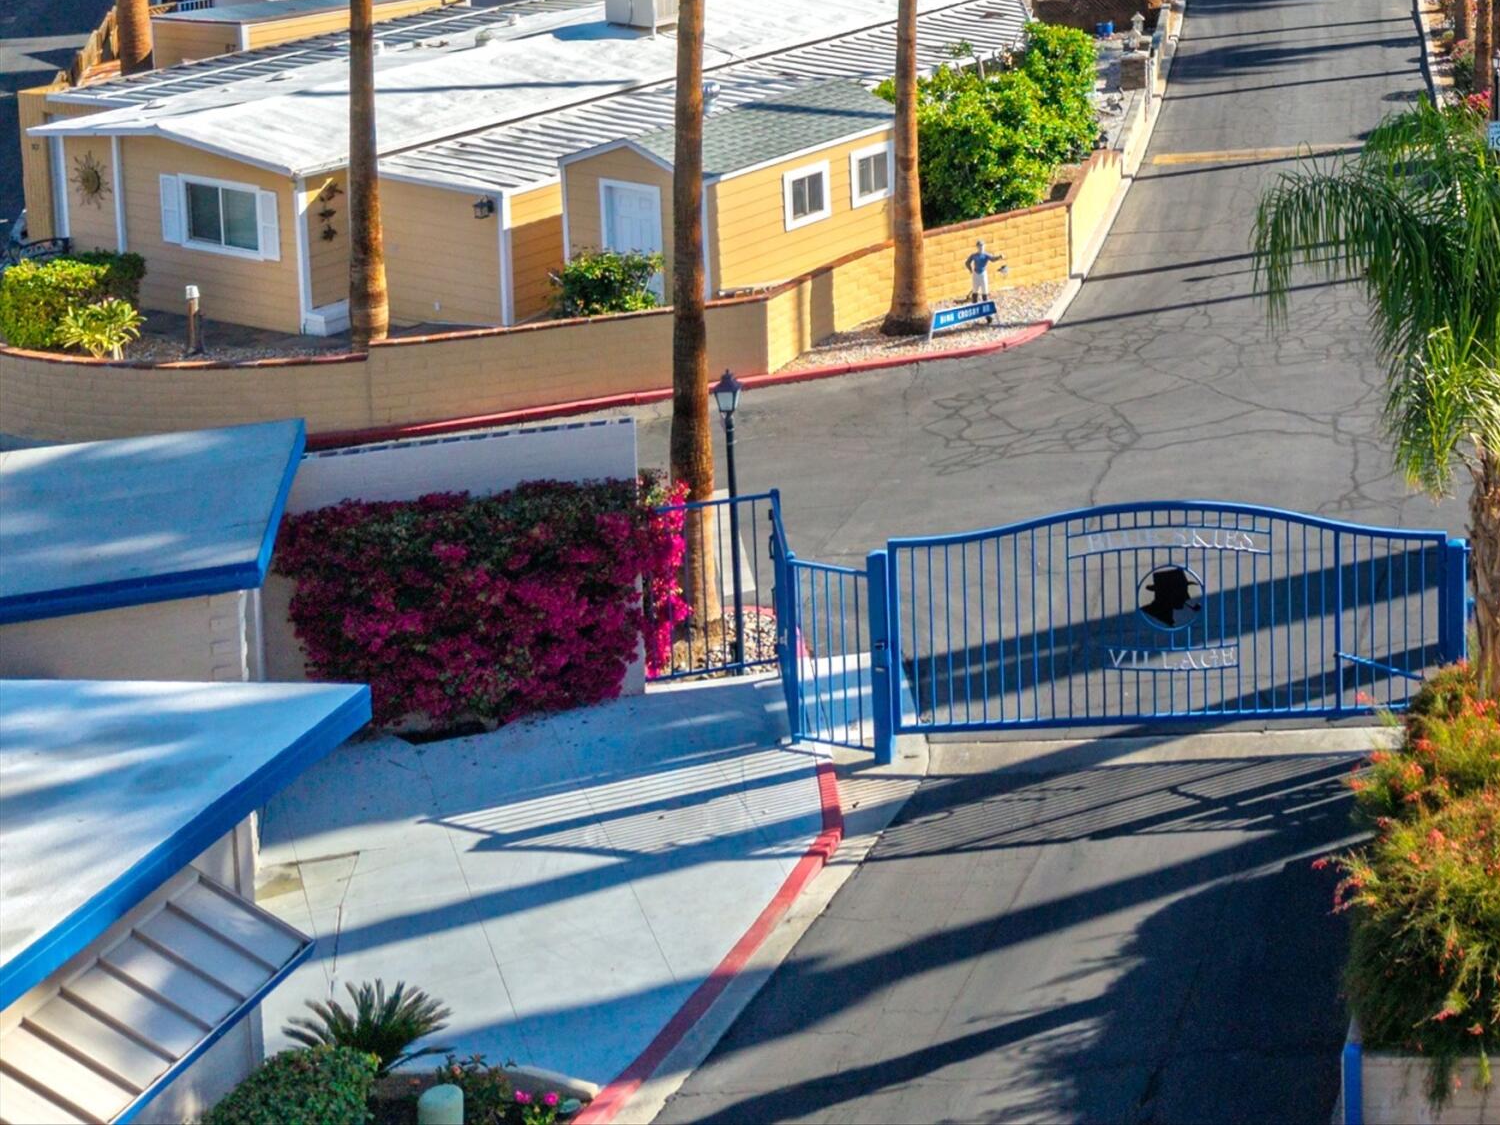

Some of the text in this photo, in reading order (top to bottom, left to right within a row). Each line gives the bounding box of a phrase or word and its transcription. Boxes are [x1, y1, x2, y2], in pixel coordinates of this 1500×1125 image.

[940, 313, 954, 325] BING
[957, 306, 980, 320] CROSBY
[1177, 528, 1254, 551] SKIES
[1108, 647, 1236, 671] VILLAGE
